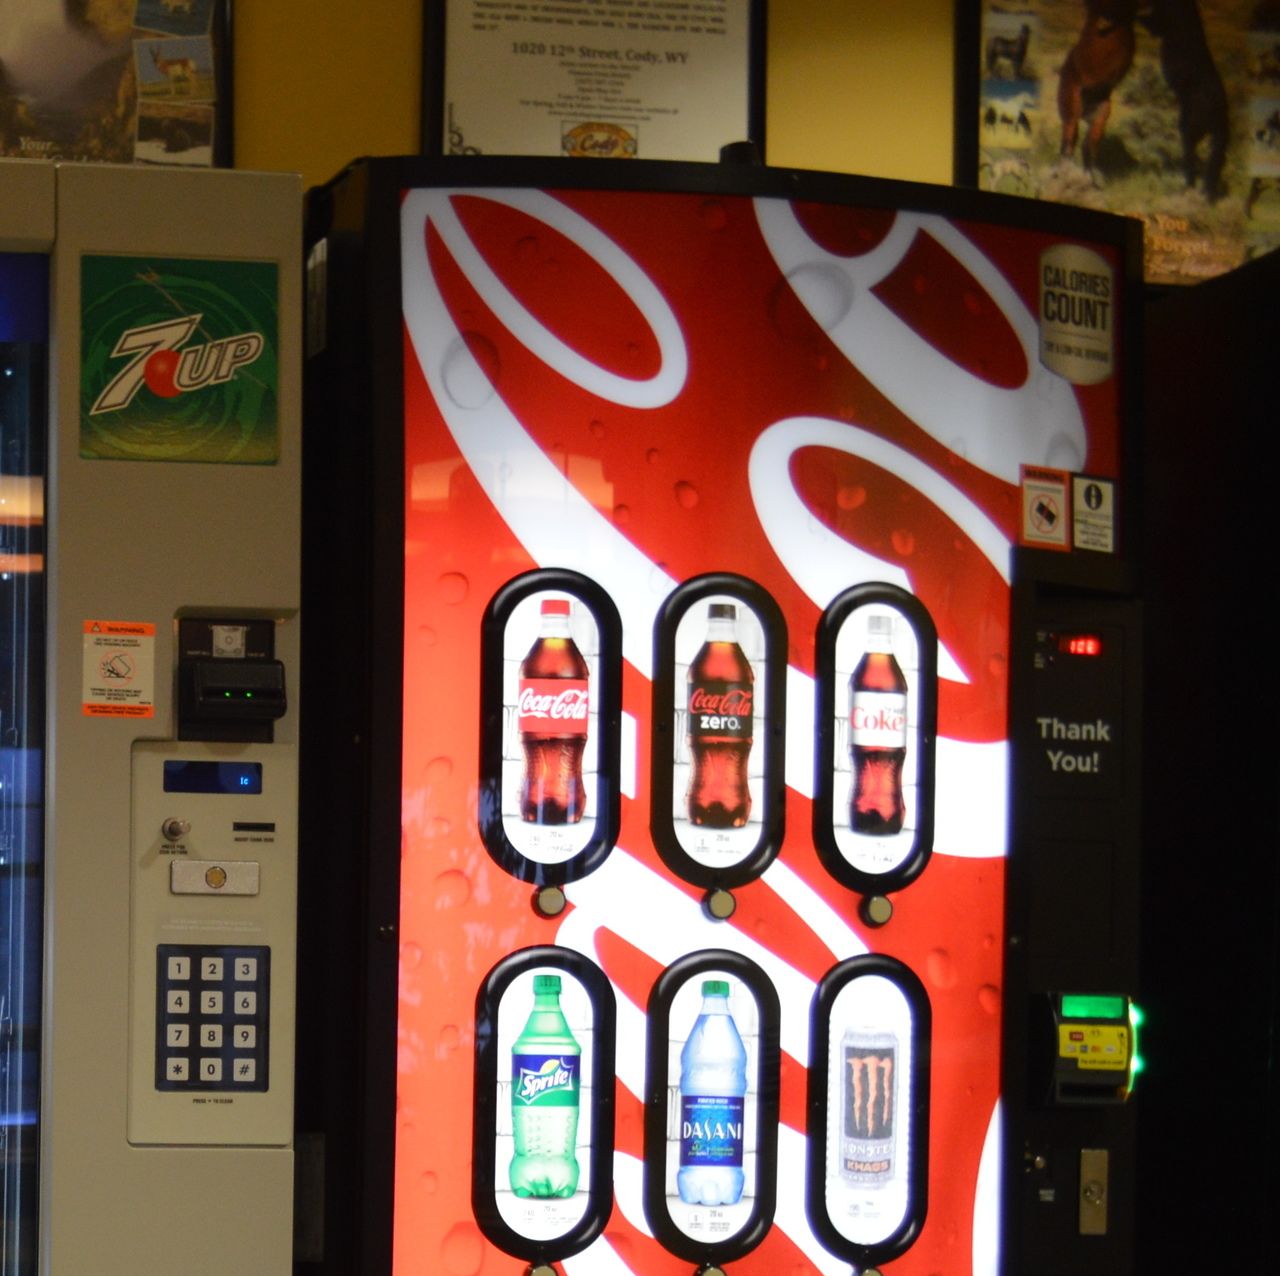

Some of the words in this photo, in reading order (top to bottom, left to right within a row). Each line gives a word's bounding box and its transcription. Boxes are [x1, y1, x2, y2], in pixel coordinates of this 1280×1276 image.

[1043, 264, 1110, 298] CALORIES
[1043, 291, 1110, 331] COUNT
[518, 687, 589, 720] Coca-Cola
[688, 687, 753, 716] Coca-Cola
[699, 714, 740, 731] zero
[849, 705, 905, 732] Coke
[1037, 717, 1111, 741] Thank
[1046, 749, 1100, 773] You!
[176, 963, 181, 974] 1
[209, 963, 217, 975] 2
[242, 963, 250, 976] 3
[174, 996, 183, 1008] 4
[208, 996, 216, 1009] 5
[241, 997, 250, 1009] 6
[174, 1029, 183, 1041] 7
[207, 1030, 216, 1042] 8
[241, 1030, 249, 1042] 9
[207, 1063, 216, 1075] 0
[521, 1066, 569, 1096] Sprite
[683, 1121, 741, 1142] DASANI
[847, 1160, 889, 1171] KHAOS
